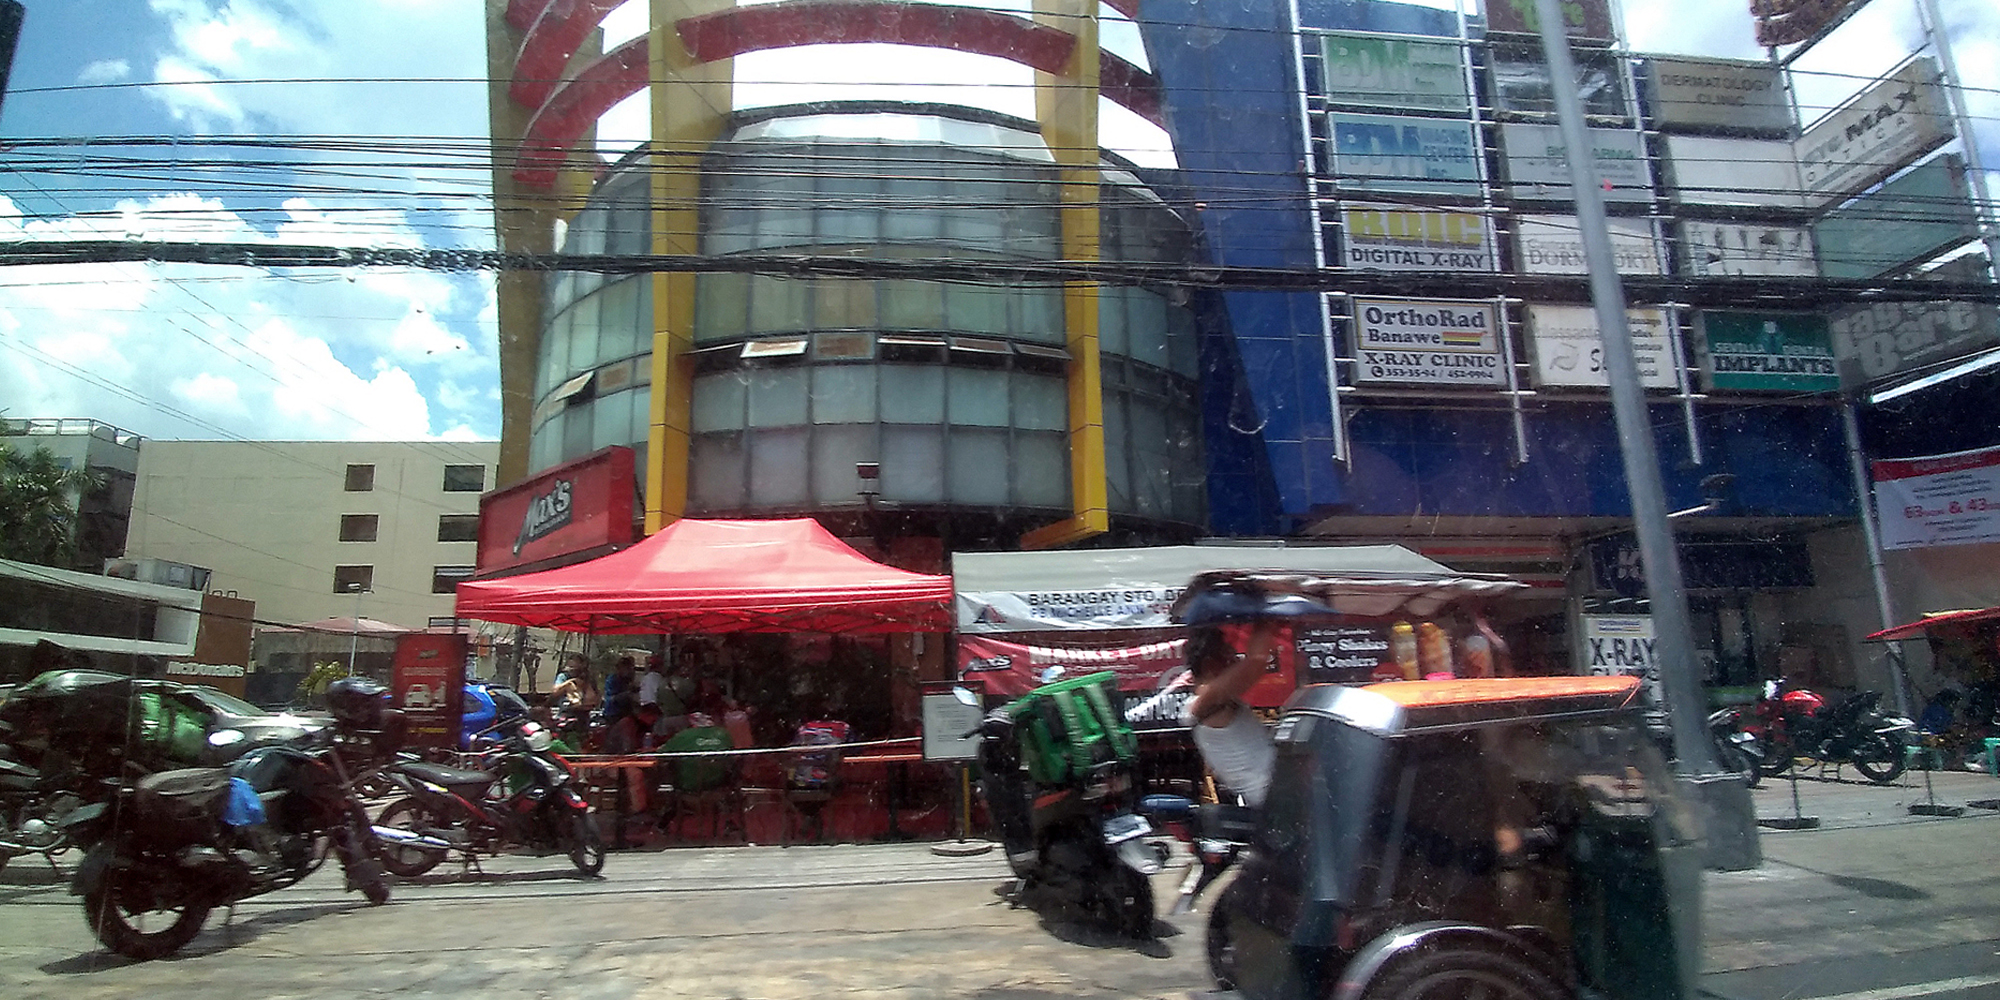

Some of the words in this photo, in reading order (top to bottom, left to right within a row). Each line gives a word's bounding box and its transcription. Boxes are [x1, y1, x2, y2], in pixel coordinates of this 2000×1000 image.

[1352, 248, 1424, 266] DIGITAL
[1432, 252, 1483, 269] X-RAY
[1365, 306, 1485, 328] OrthoRad
[1367, 328, 1440, 344] Banawe
[1365, 352, 1424, 366] X-RAY
[1430, 355, 1496, 368] CLINIC
[1714, 355, 1835, 375] IMPLANTS
[1029, 591, 1118, 606] BARANGAY
[1124, 590, 1161, 603] STO.
[1590, 637, 1657, 667] X-RAY
